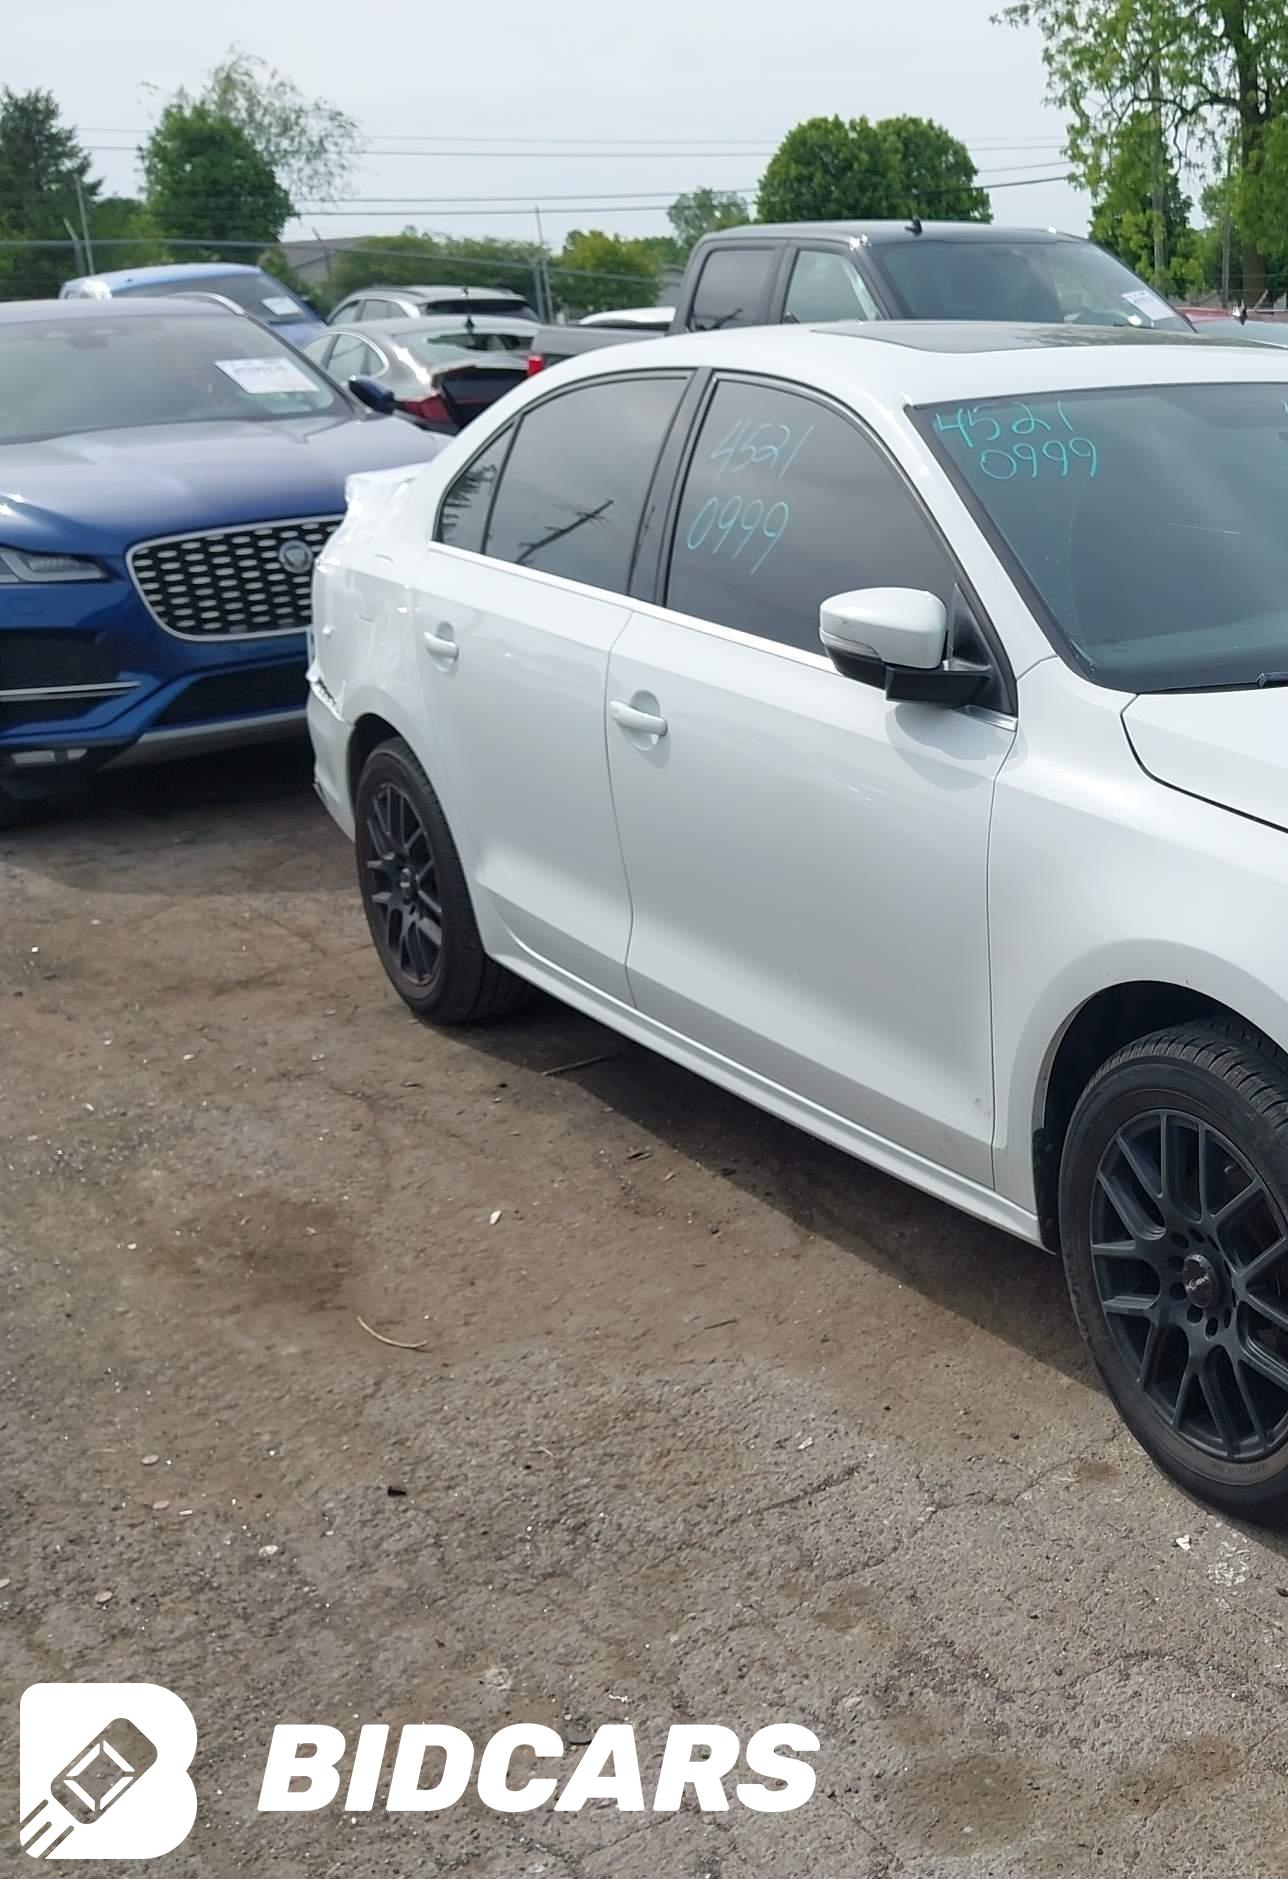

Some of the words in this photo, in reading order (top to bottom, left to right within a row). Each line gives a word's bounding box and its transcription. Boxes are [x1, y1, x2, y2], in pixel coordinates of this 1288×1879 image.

[709, 418, 815, 481] 4521
[933, 400, 1074, 448] 4521
[980, 436, 1098, 480] 0999
[687, 495, 789, 576] 0999
